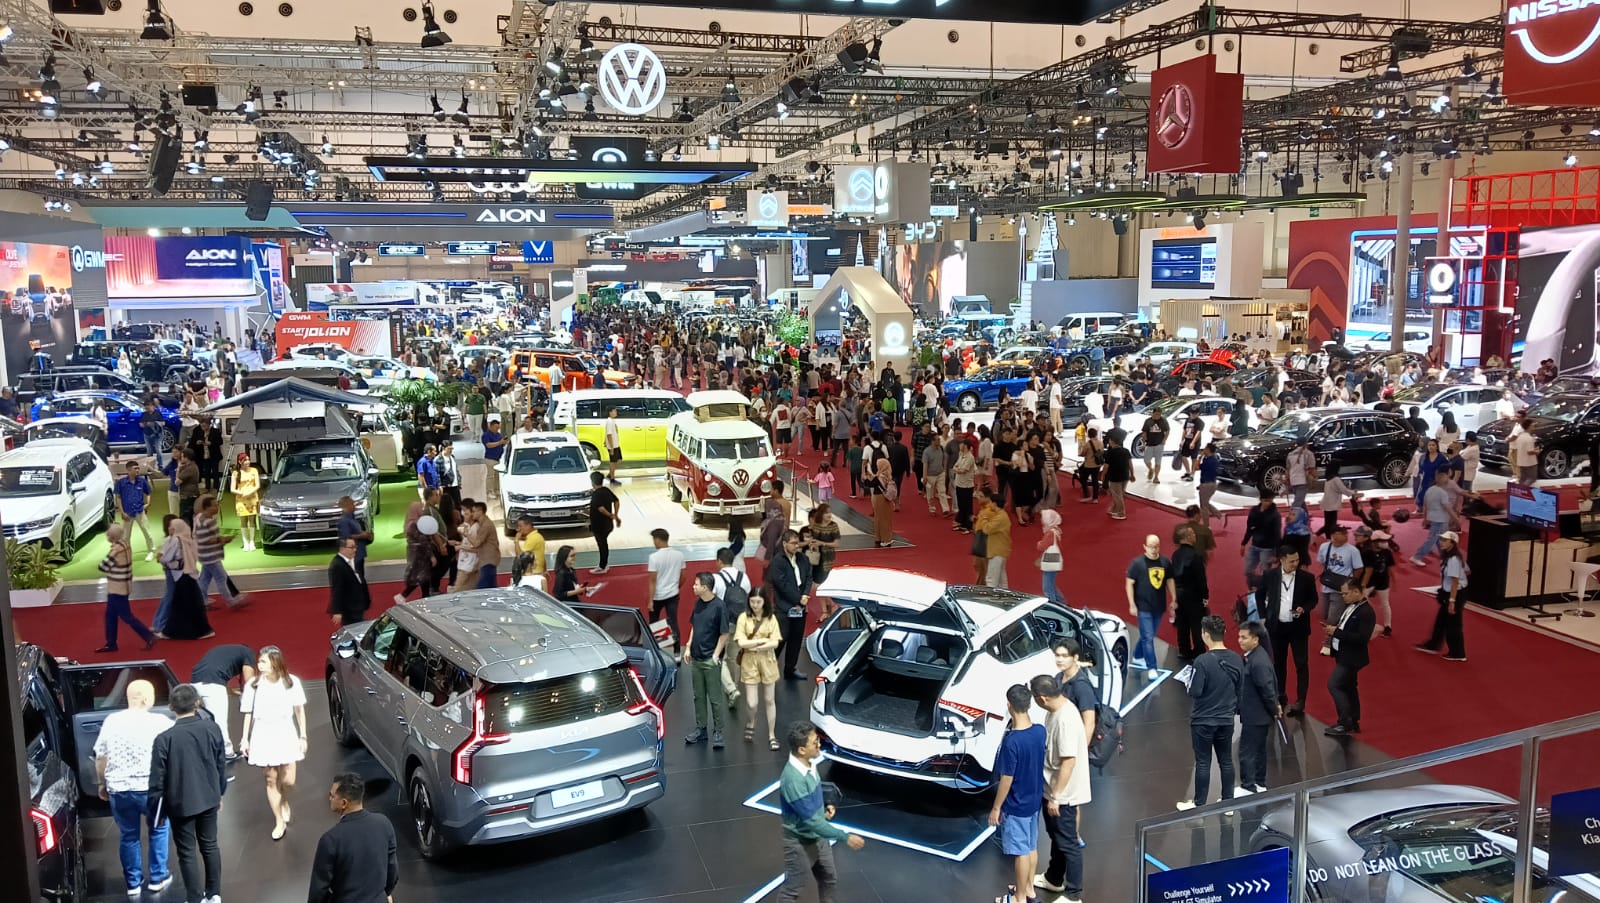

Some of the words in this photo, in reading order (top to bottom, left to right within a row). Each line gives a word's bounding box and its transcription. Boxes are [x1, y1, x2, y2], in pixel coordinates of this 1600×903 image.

[476, 208, 546, 223] AION
[185, 249, 237, 260] AION
[303, 327, 351, 340] JOLION
[571, 789, 585, 799] EV9
[1309, 868, 1328, 883] DO
[1335, 864, 1361, 880] NOT
[1362, 856, 1399, 875] LEAN
[1400, 854, 1421, 869] ON
[1422, 848, 1451, 866] THE
[1453, 841, 1502, 861] GLASS
[1164, 889, 1191, 899] Challenge
[1191, 883, 1215, 895] Yourself
